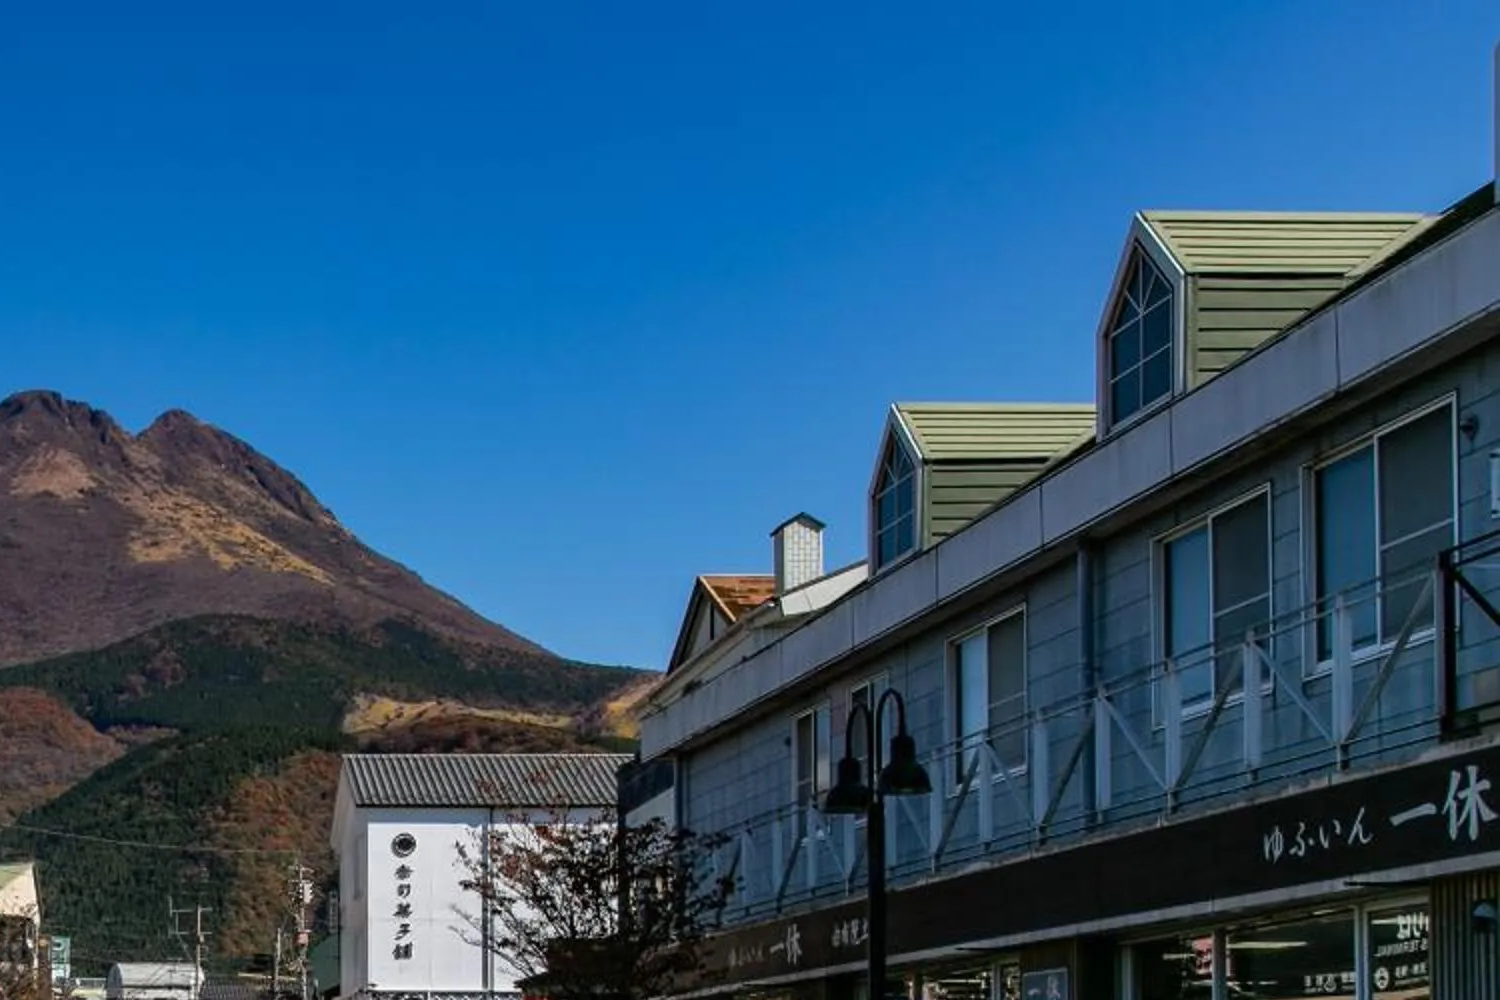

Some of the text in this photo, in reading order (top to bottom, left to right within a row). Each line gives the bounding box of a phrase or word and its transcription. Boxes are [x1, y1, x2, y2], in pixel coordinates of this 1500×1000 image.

[1263, 764, 1499, 864] ゆふいん 一休
